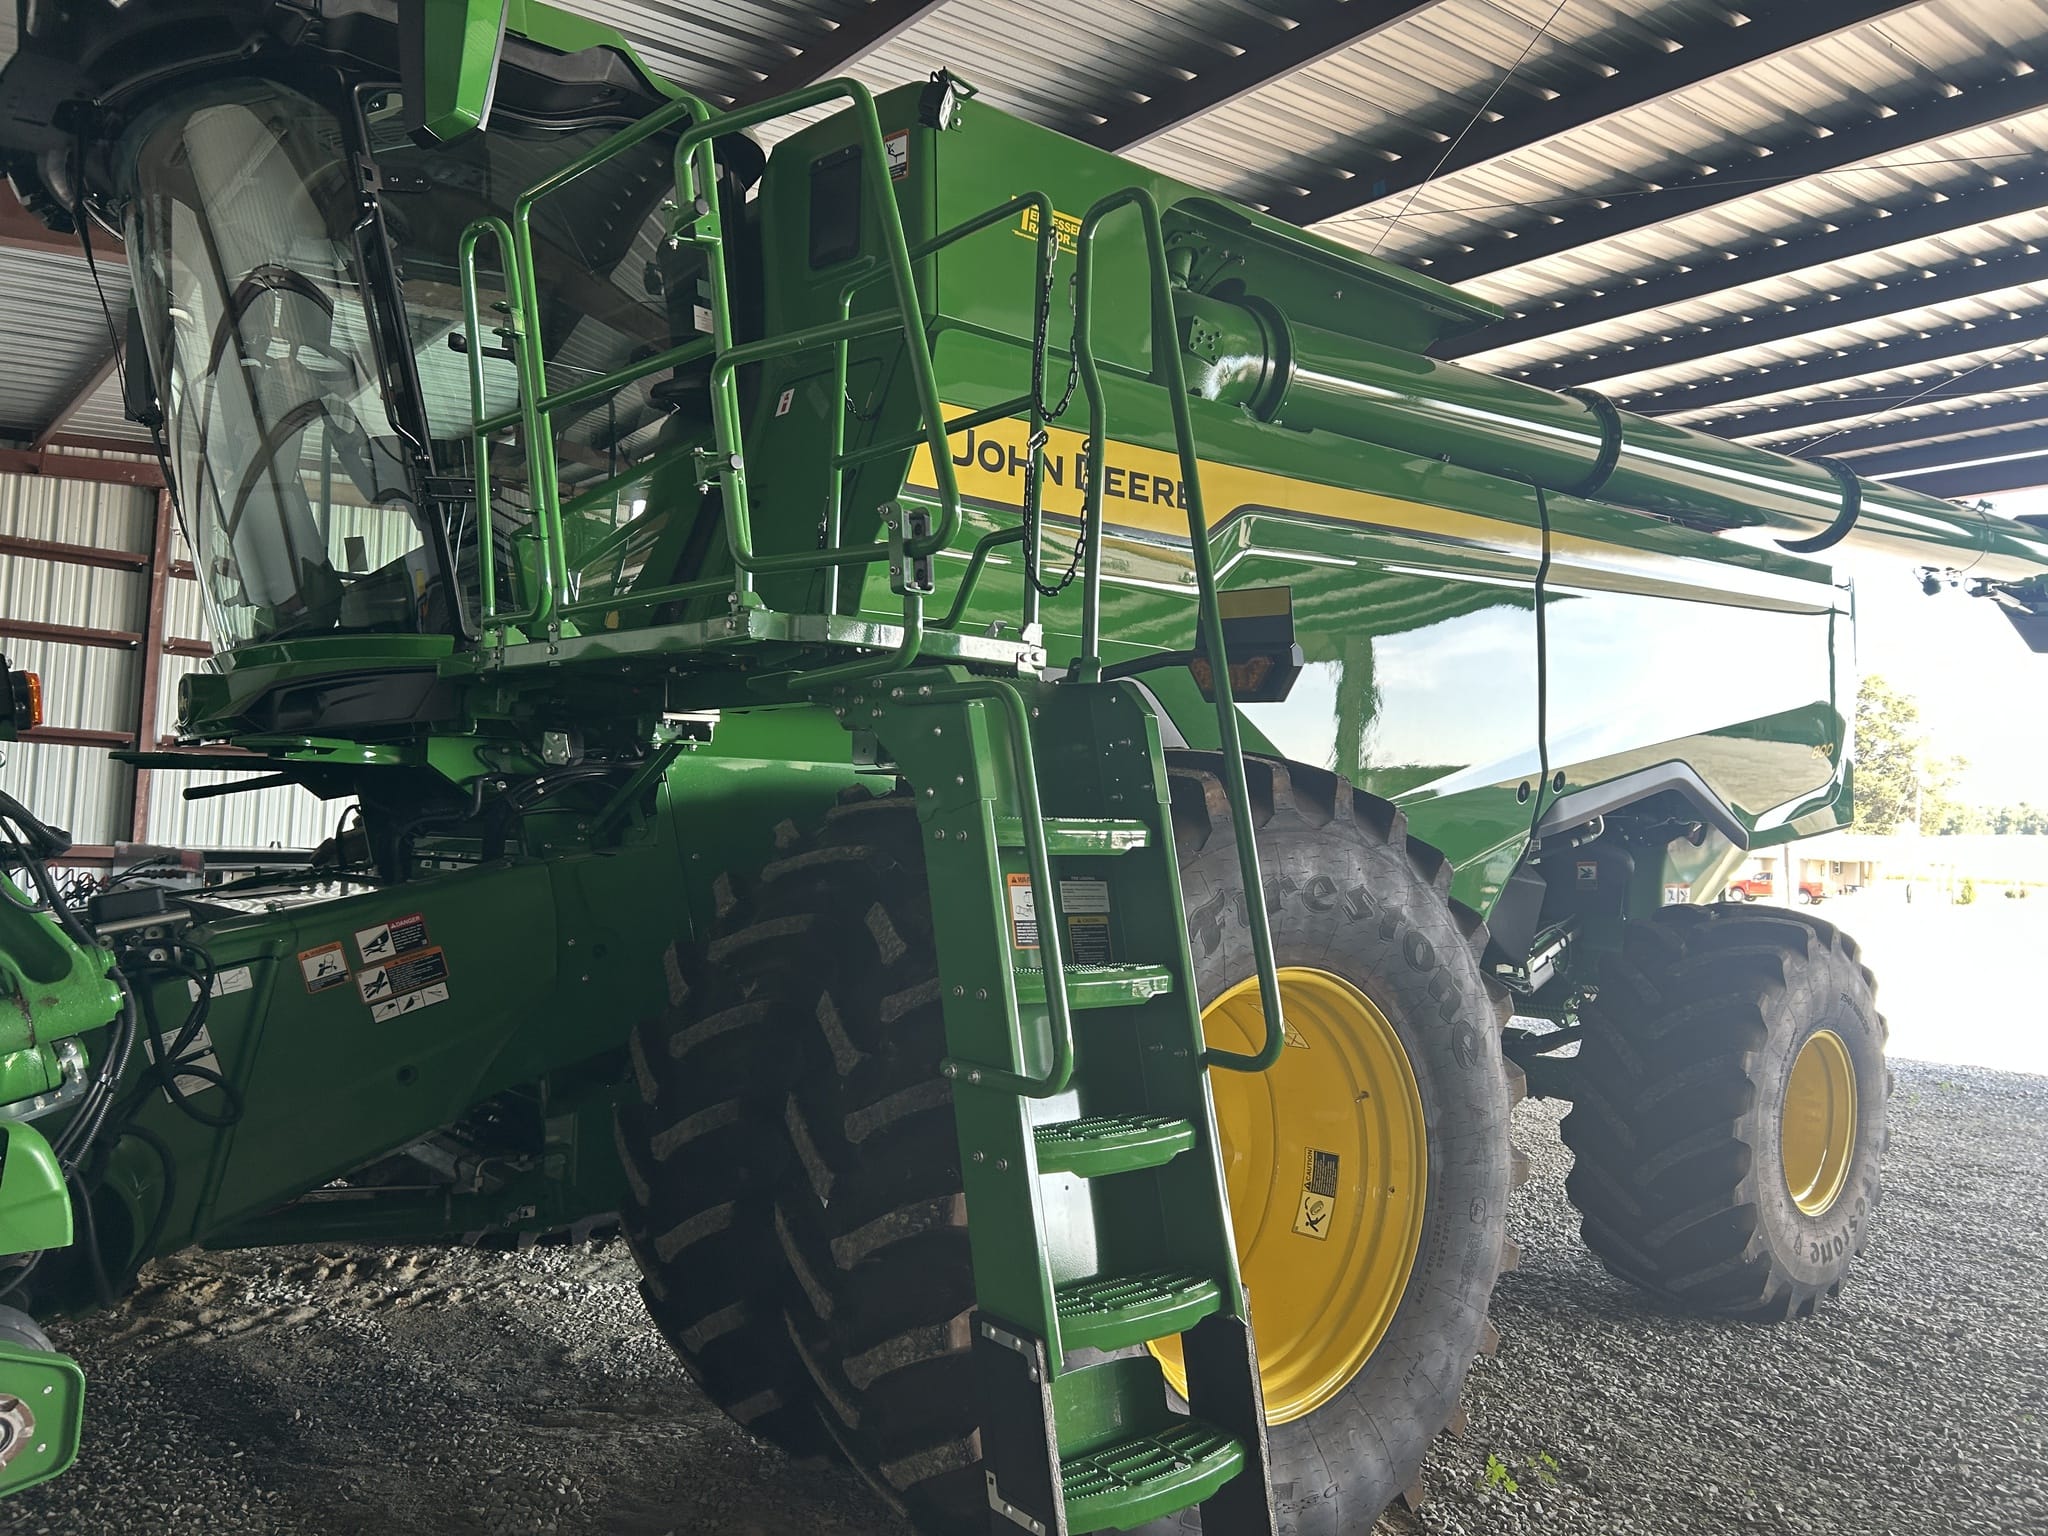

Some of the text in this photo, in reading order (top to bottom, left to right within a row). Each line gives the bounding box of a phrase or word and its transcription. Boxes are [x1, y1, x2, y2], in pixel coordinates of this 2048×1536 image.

[952, 429, 1064, 487] JOHN
[1811, 742, 1834, 760] 800
[395, 915, 421, 928] DANGER
[1305, 1149, 1313, 1183] CAUTION
